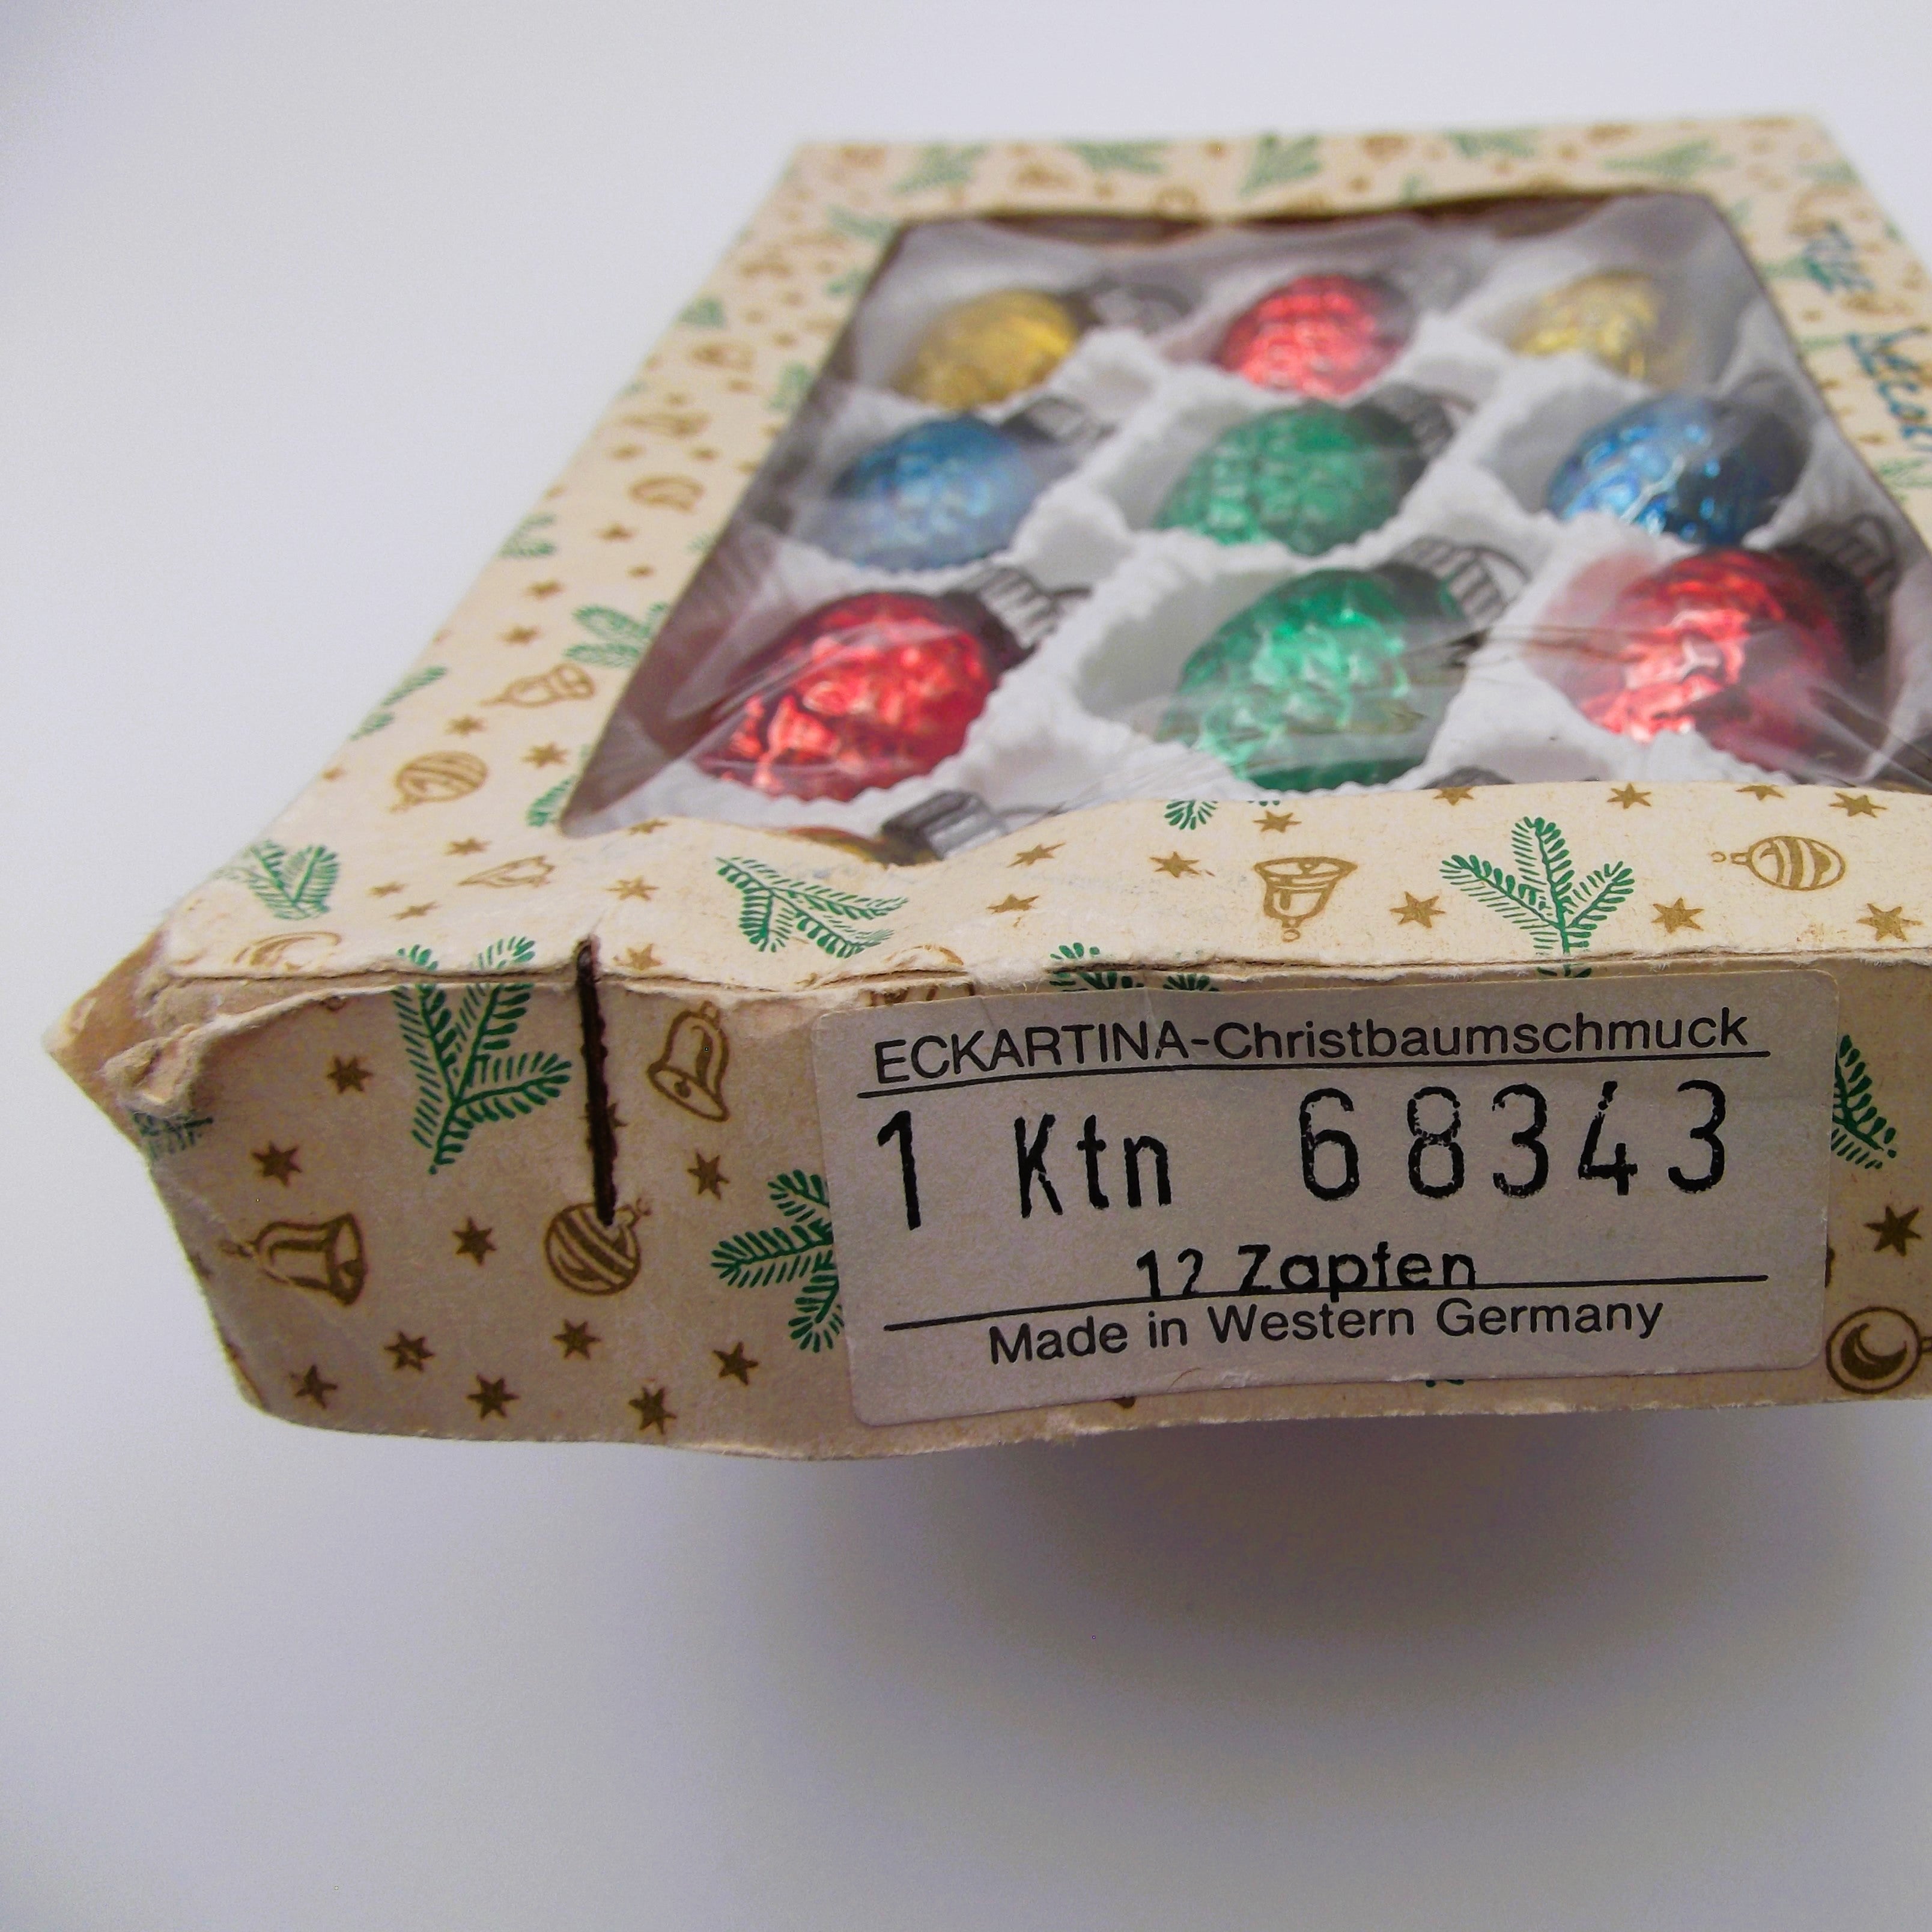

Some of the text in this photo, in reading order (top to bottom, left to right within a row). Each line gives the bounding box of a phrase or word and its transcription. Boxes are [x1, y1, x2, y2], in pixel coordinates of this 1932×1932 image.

[875, 1007, 1748, 1083] ECKARTINA-Christbaumschmuck
[877, 1110, 922, 1230] 1
[1014, 1113, 1171, 1219] Ktn
[989, 1298, 1663, 1364] Made in Western Germany
